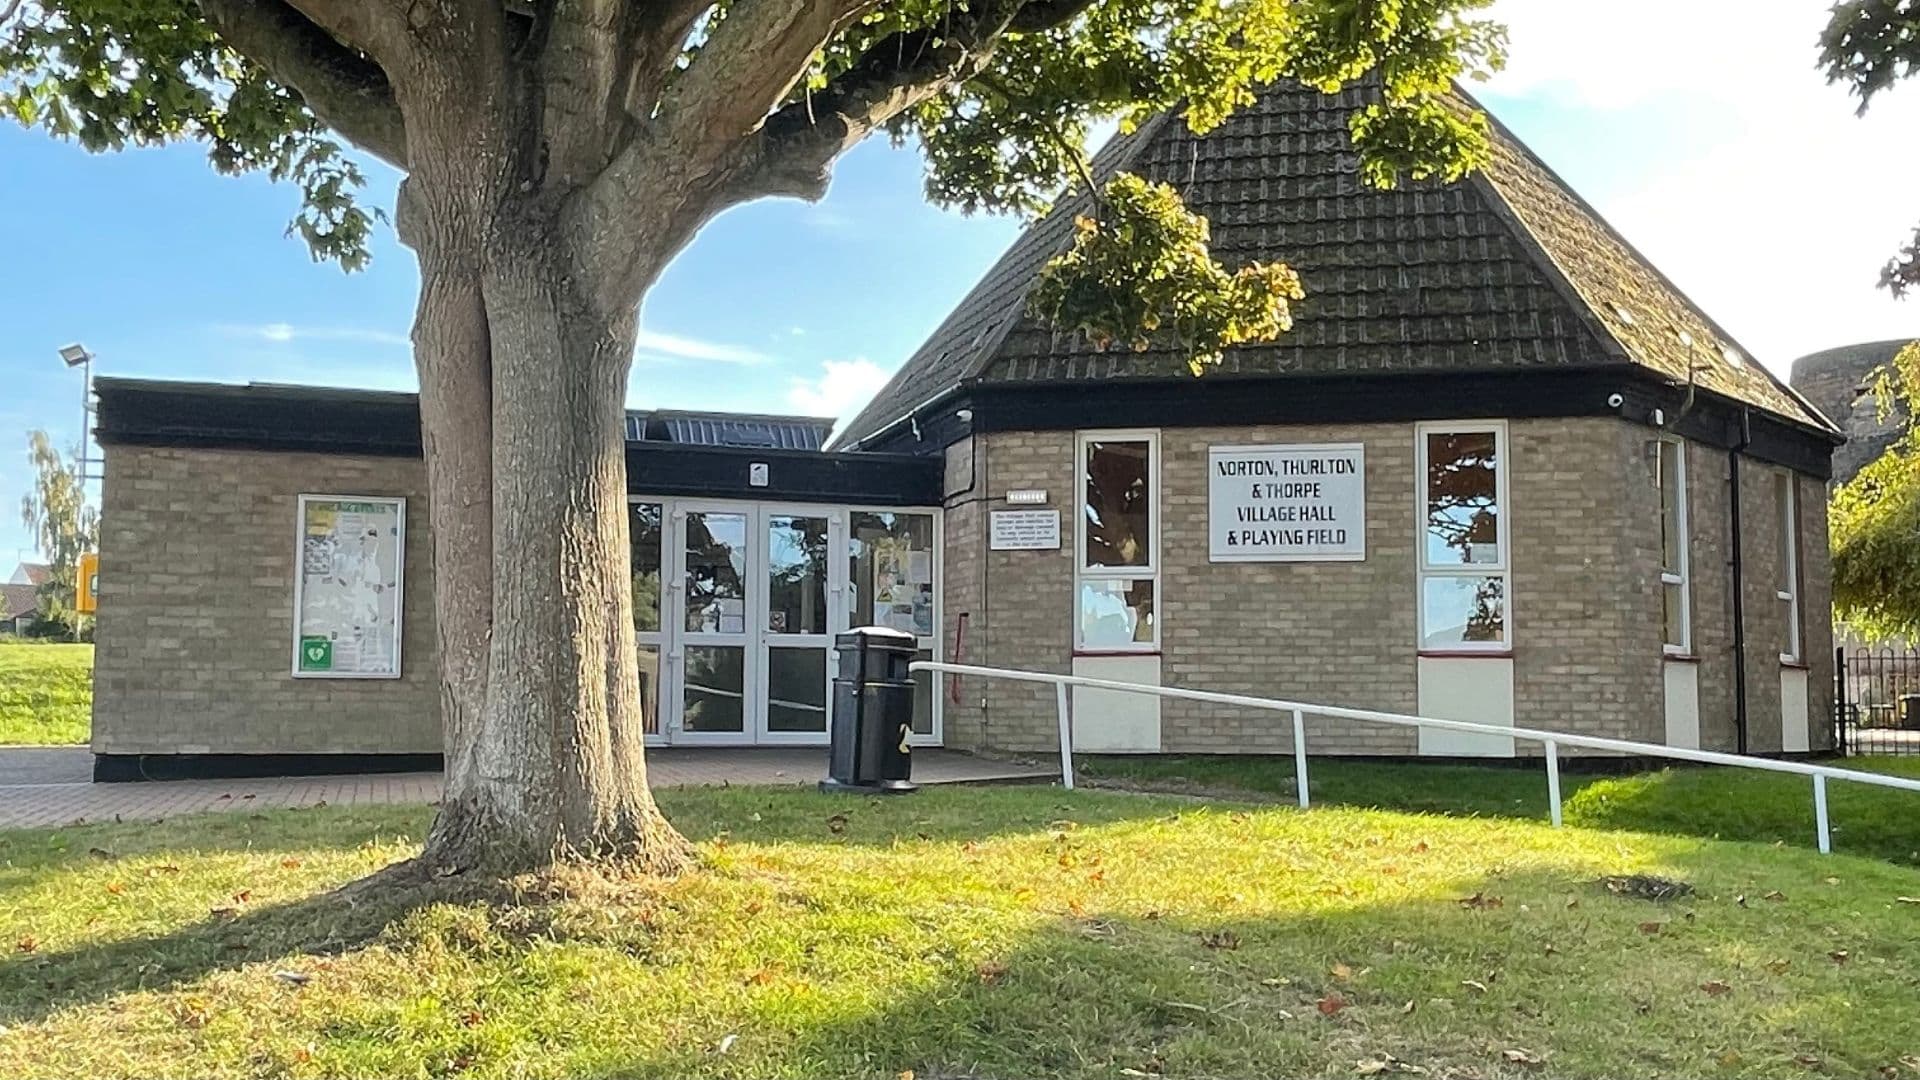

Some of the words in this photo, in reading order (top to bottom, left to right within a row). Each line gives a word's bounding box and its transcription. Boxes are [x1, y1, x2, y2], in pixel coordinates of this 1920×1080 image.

[1217, 460, 1279, 477] NORTON,
[1282, 459, 1356, 475] THURLTON
[1252, 483, 1262, 499] &
[1266, 482, 1321, 499] THORPE
[1237, 506, 1297, 522] VILLAGE
[1299, 505, 1336, 521] HALL
[1227, 530, 1238, 545] &
[1242, 529, 1303, 545] PLAYING
[1307, 529, 1346, 545] FIELD
